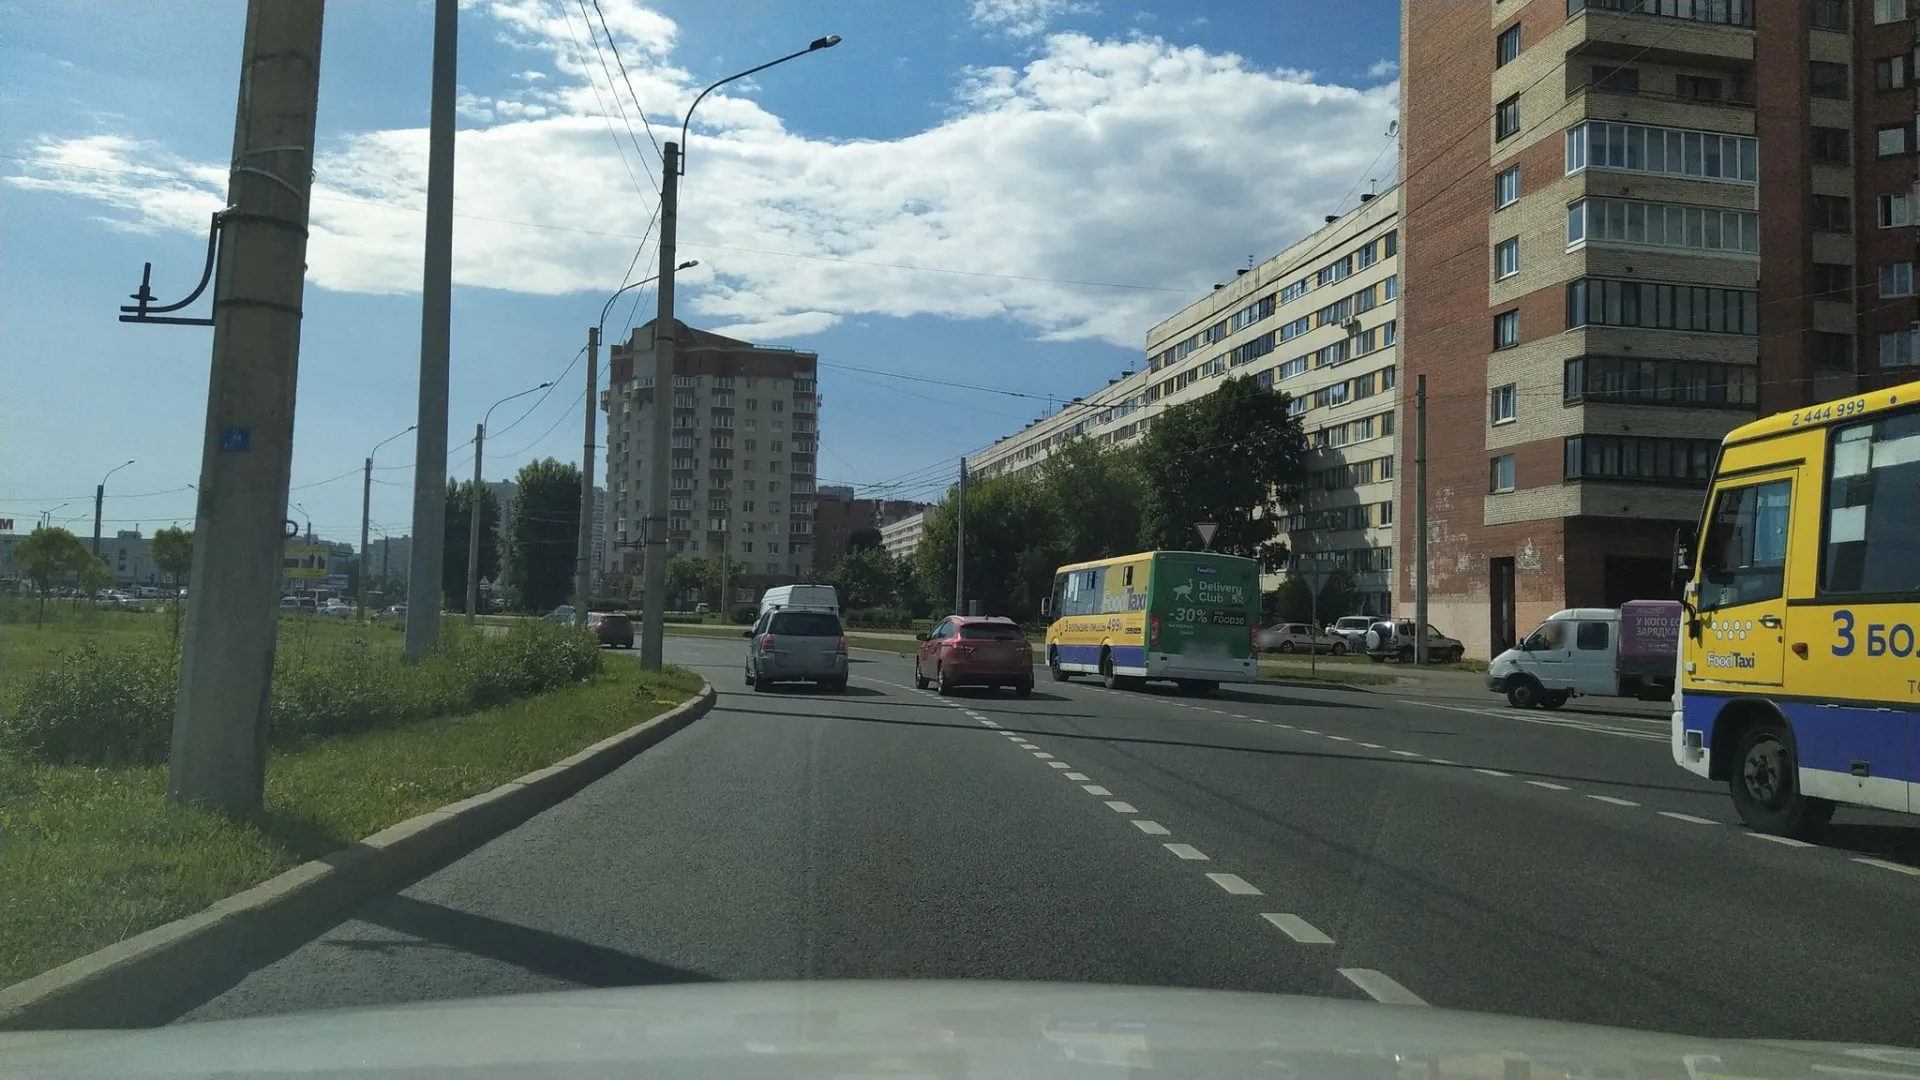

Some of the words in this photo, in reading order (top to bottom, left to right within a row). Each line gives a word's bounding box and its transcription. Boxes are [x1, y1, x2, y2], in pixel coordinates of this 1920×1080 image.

[1792, 413, 1799, 426] 2
[1803, 406, 1831, 423] 444
[1837, 399, 1865, 416] 999
[1199, 580, 1243, 595] Delivery
[1198, 592, 1224, 603] Club
[1168, 608, 1208, 623] -30%
[1213, 615, 1245, 625] FOOD30
[1636, 617, 1642, 626] У
[1644, 617, 1668, 627] КОГО
[1064, 620, 1069, 632] 3
[1636, 626, 1680, 639] ЗАРЯДКА
[1831, 609, 1855, 657] 3
[1867, 623, 1920, 658] БО
[1707, 651, 1755, 668] FoodTaxi
[1907, 679, 1920, 695] Т
